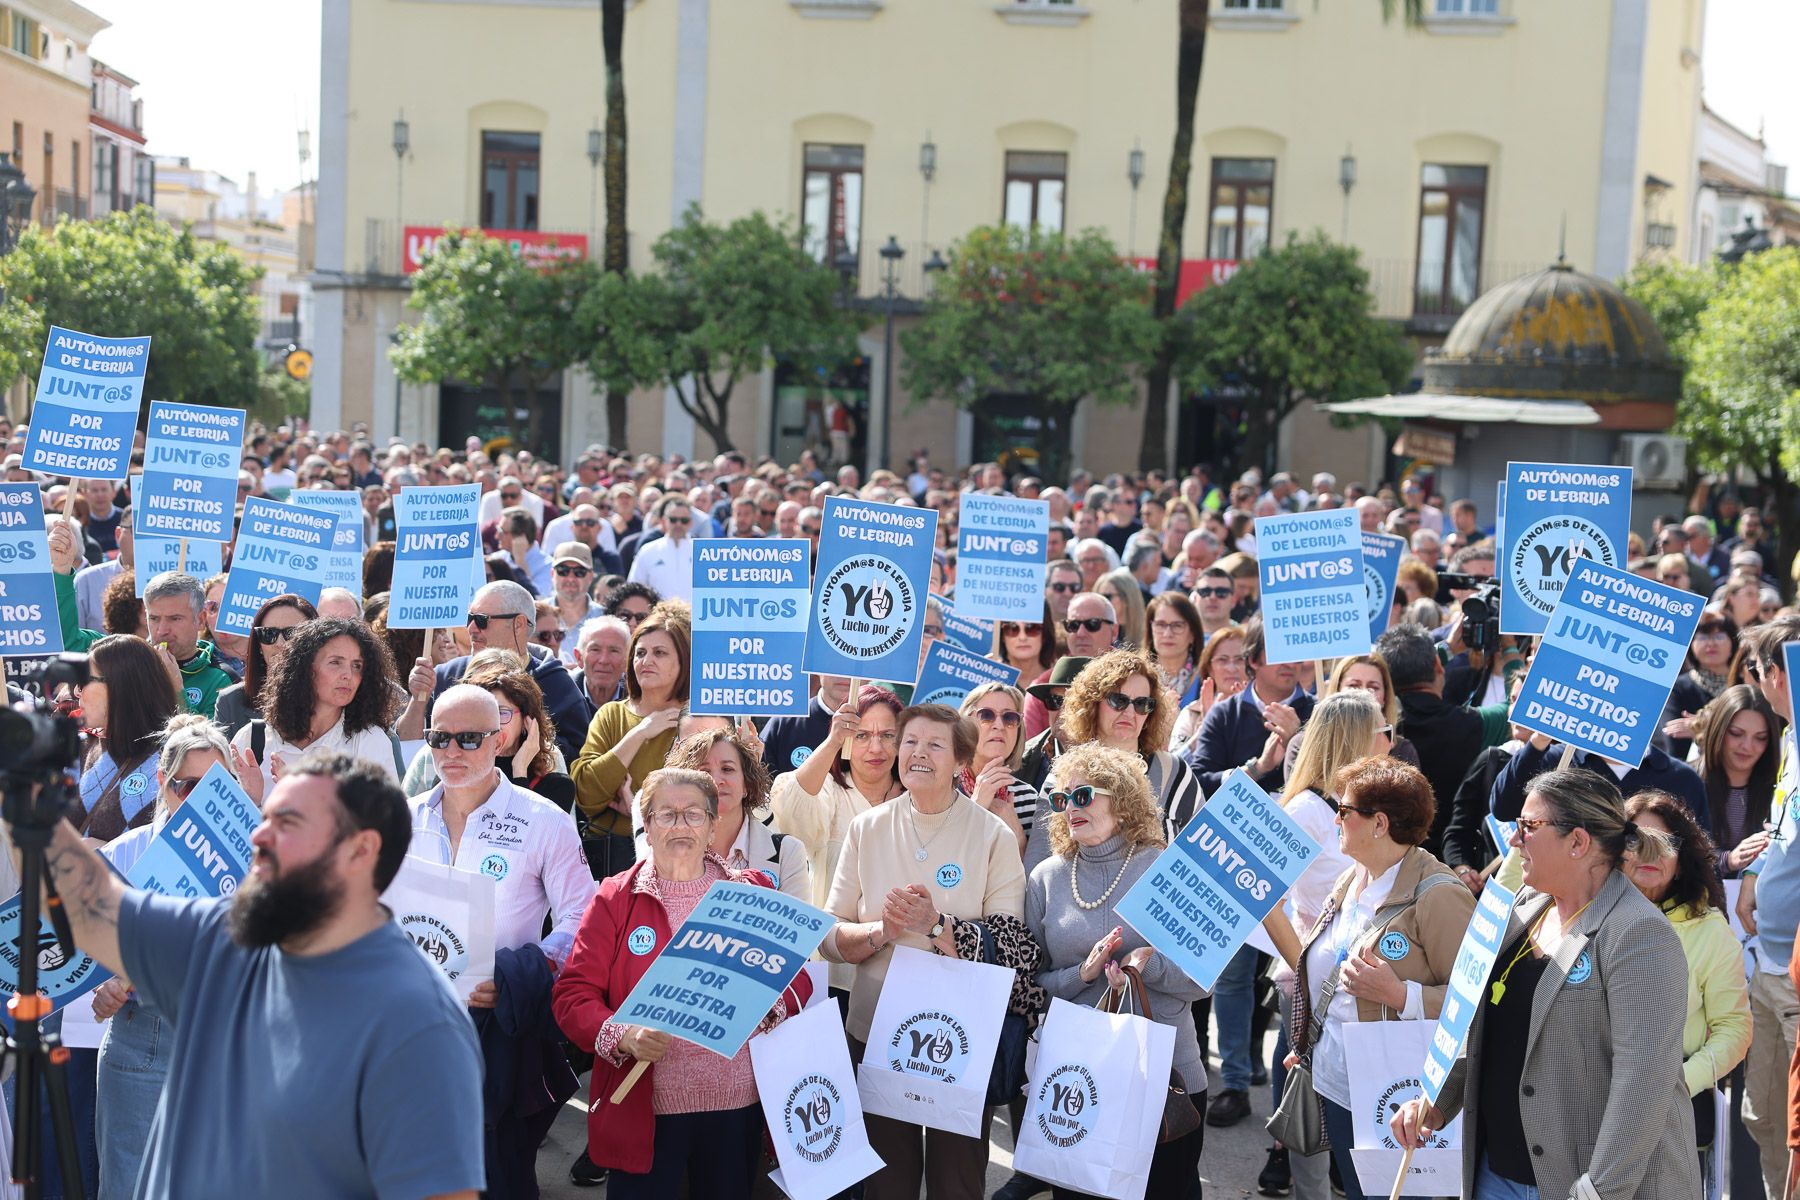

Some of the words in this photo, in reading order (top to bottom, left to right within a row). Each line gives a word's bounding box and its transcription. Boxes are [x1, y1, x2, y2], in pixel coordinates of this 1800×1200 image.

[55, 336, 143, 357] AUTÓNOM@S
[61, 354, 81, 367] DE
[84, 360, 133, 374] LEBRIJA
[45, 376, 132, 403] JUNT@S
[69, 414, 102, 430] POR
[155, 409, 239, 427] AUTÓNOM@S
[39, 429, 121, 451] NUESTROS
[161, 425, 178, 435] DE
[181, 427, 230, 441] LEBRIJA
[33, 450, 118, 471] DERECHOS
[151, 446, 230, 468] JUNT@S
[173, 478, 202, 493] POR
[1518, 471, 1620, 487] AUTÓNOM@S
[149, 496, 223, 515] NUESTROS
[407, 492, 476, 505] AUTÓNOM@S
[966, 500, 1044, 515] AUTÓNOM@S
[1526, 489, 1547, 501] DE
[1551, 490, 1609, 506] LEBRIJA
[146, 514, 221, 533] DERECHOS
[250, 505, 332, 529] AUTÓNOM@S
[413, 510, 426, 520] DE
[429, 509, 469, 521] LEBRIJA
[833, 506, 925, 529] AUTÓNOM@S
[972, 515, 987, 524] DE
[991, 517, 1035, 528] LEBRIJA
[254, 522, 270, 533] DE
[273, 526, 320, 544] LEBRIJA
[839, 525, 857, 538] DE
[859, 527, 913, 546] LEBRIJA
[1263, 517, 1353, 536] AUTÓNOM@S
[401, 532, 469, 553] JUNT@S
[964, 535, 1038, 555] JUNT@S
[1272, 541, 1288, 551] DE
[1293, 535, 1346, 549] LEBRIJA
[1515, 519, 1569, 568] AUTÓNOM@S
[1573, 520, 1587, 530] DE
[240, 544, 319, 571] JUNT@S
[330, 557, 353, 566] ENSA
[699, 545, 802, 563] AUTÓNOM@S
[149, 561, 208, 572] NUETRA
[423, 566, 447, 578] POR
[708, 569, 728, 581] DE
[732, 569, 793, 584] LEBRIJA
[968, 564, 982, 574] EN
[985, 566, 1034, 578] DEFENSA
[1267, 557, 1353, 586] JUNT@S
[258, 577, 287, 594] POR
[405, 585, 458, 599] NUESTRA
[822, 558, 875, 606] AUTÓNOM@S
[877, 560, 891, 572] DE
[891, 569, 911, 612] LEBRIJA
[963, 579, 977, 589] DE
[980, 580, 1037, 593] NUESTROS
[1517, 578, 1555, 613] NUESTRO
[1539, 579, 1565, 591] Luch
[1577, 568, 1694, 618] AUTÓNOM@S
[699, 598, 796, 620] JUNT@S
[972, 594, 1026, 607] TRABAJOS
[1275, 598, 1291, 611] EN
[1295, 593, 1353, 607] DEFENSA
[399, 606, 458, 619] DIGNIDAD
[1272, 618, 1288, 629] DE
[1291, 610, 1359, 626] NUESTROS
[1581, 589, 1604, 609] DE
[1607, 599, 1675, 635] LEBRIJA
[822, 616, 857, 656] NUESTROS
[860, 627, 906, 657] DERECHOS
[842, 619, 870, 632] Lucho
[873, 624, 889, 635] por
[1284, 629, 1349, 645] TRABAJOS
[729, 638, 764, 655] POR
[1555, 615, 1669, 669] JUNT@S
[702, 663, 792, 680] NUESTROS
[936, 648, 1009, 679] AUTÓNOM@S
[939, 663, 954, 674] DE
[1576, 664, 1620, 693] POR
[701, 688, 793, 706] DERECHOS
[1536, 677, 1640, 728] NUESTROS
[1525, 702, 1631, 752] DERECHOS
[205, 800, 224, 824] DE
[504, 813, 529, 826] Jeans
[1229, 782, 1311, 860] AUTÓNOM@S
[478, 832, 492, 840] Est.
[496, 835, 522, 843] London
[488, 822, 517, 833] 1973
[1222, 804, 1243, 825] DE
[1240, 816, 1289, 870] LEBRIJA
[172, 817, 237, 895] JUNT@
[1187, 823, 1272, 900] JUNT@S
[176, 875, 198, 897] PO
[1170, 859, 1188, 880] EN
[1186, 873, 1241, 929] DEFENSA
[711, 889, 823, 932] AUTÓNOM@S
[1151, 873, 1171, 894] DE
[1167, 887, 1230, 948] NUESTROS
[708, 906, 732, 919] DE
[734, 911, 798, 944] LEBRIJA
[1145, 898, 1207, 957] TRABAJOS
[429, 918, 440, 927] DE
[441, 925, 464, 955] LEBRIJA
[674, 930, 787, 974] JUNT@S
[66, 958, 92, 983] BRIJA
[686, 967, 729, 990] POR
[650, 983, 736, 1021] NUESTRA
[630, 1003, 726, 1041] DIGNIDAD
[892, 1012, 939, 1048] AUTÓNOM@S
[941, 1015, 953, 1024] DE
[952, 1022, 968, 1055] LEBRIJA
[906, 1059, 930, 1072] Lucho
[932, 1066, 946, 1076] por
[1039, 1064, 1080, 1101] AUTÓNOM@S
[1085, 1070, 1097, 1106] LEBRIJA
[785, 1076, 808, 1134] AUTÓNOM@S
[809, 1076, 818, 1084] DE
[820, 1076, 840, 1103] LEBRIJA
[1376, 1079, 1411, 1124] AUTÓNOM@S
[1038, 1113, 1058, 1146] NUESTROS
[1059, 1127, 1088, 1148] DERECHOS
[1049, 1113, 1067, 1127] Lucho
[1068, 1120, 1079, 1129] por
[796, 1142, 823, 1162] NUESTROS
[823, 1126, 842, 1160] DERECHOS
[806, 1130, 822, 1146] Lucho
[824, 1125, 834, 1138] por
